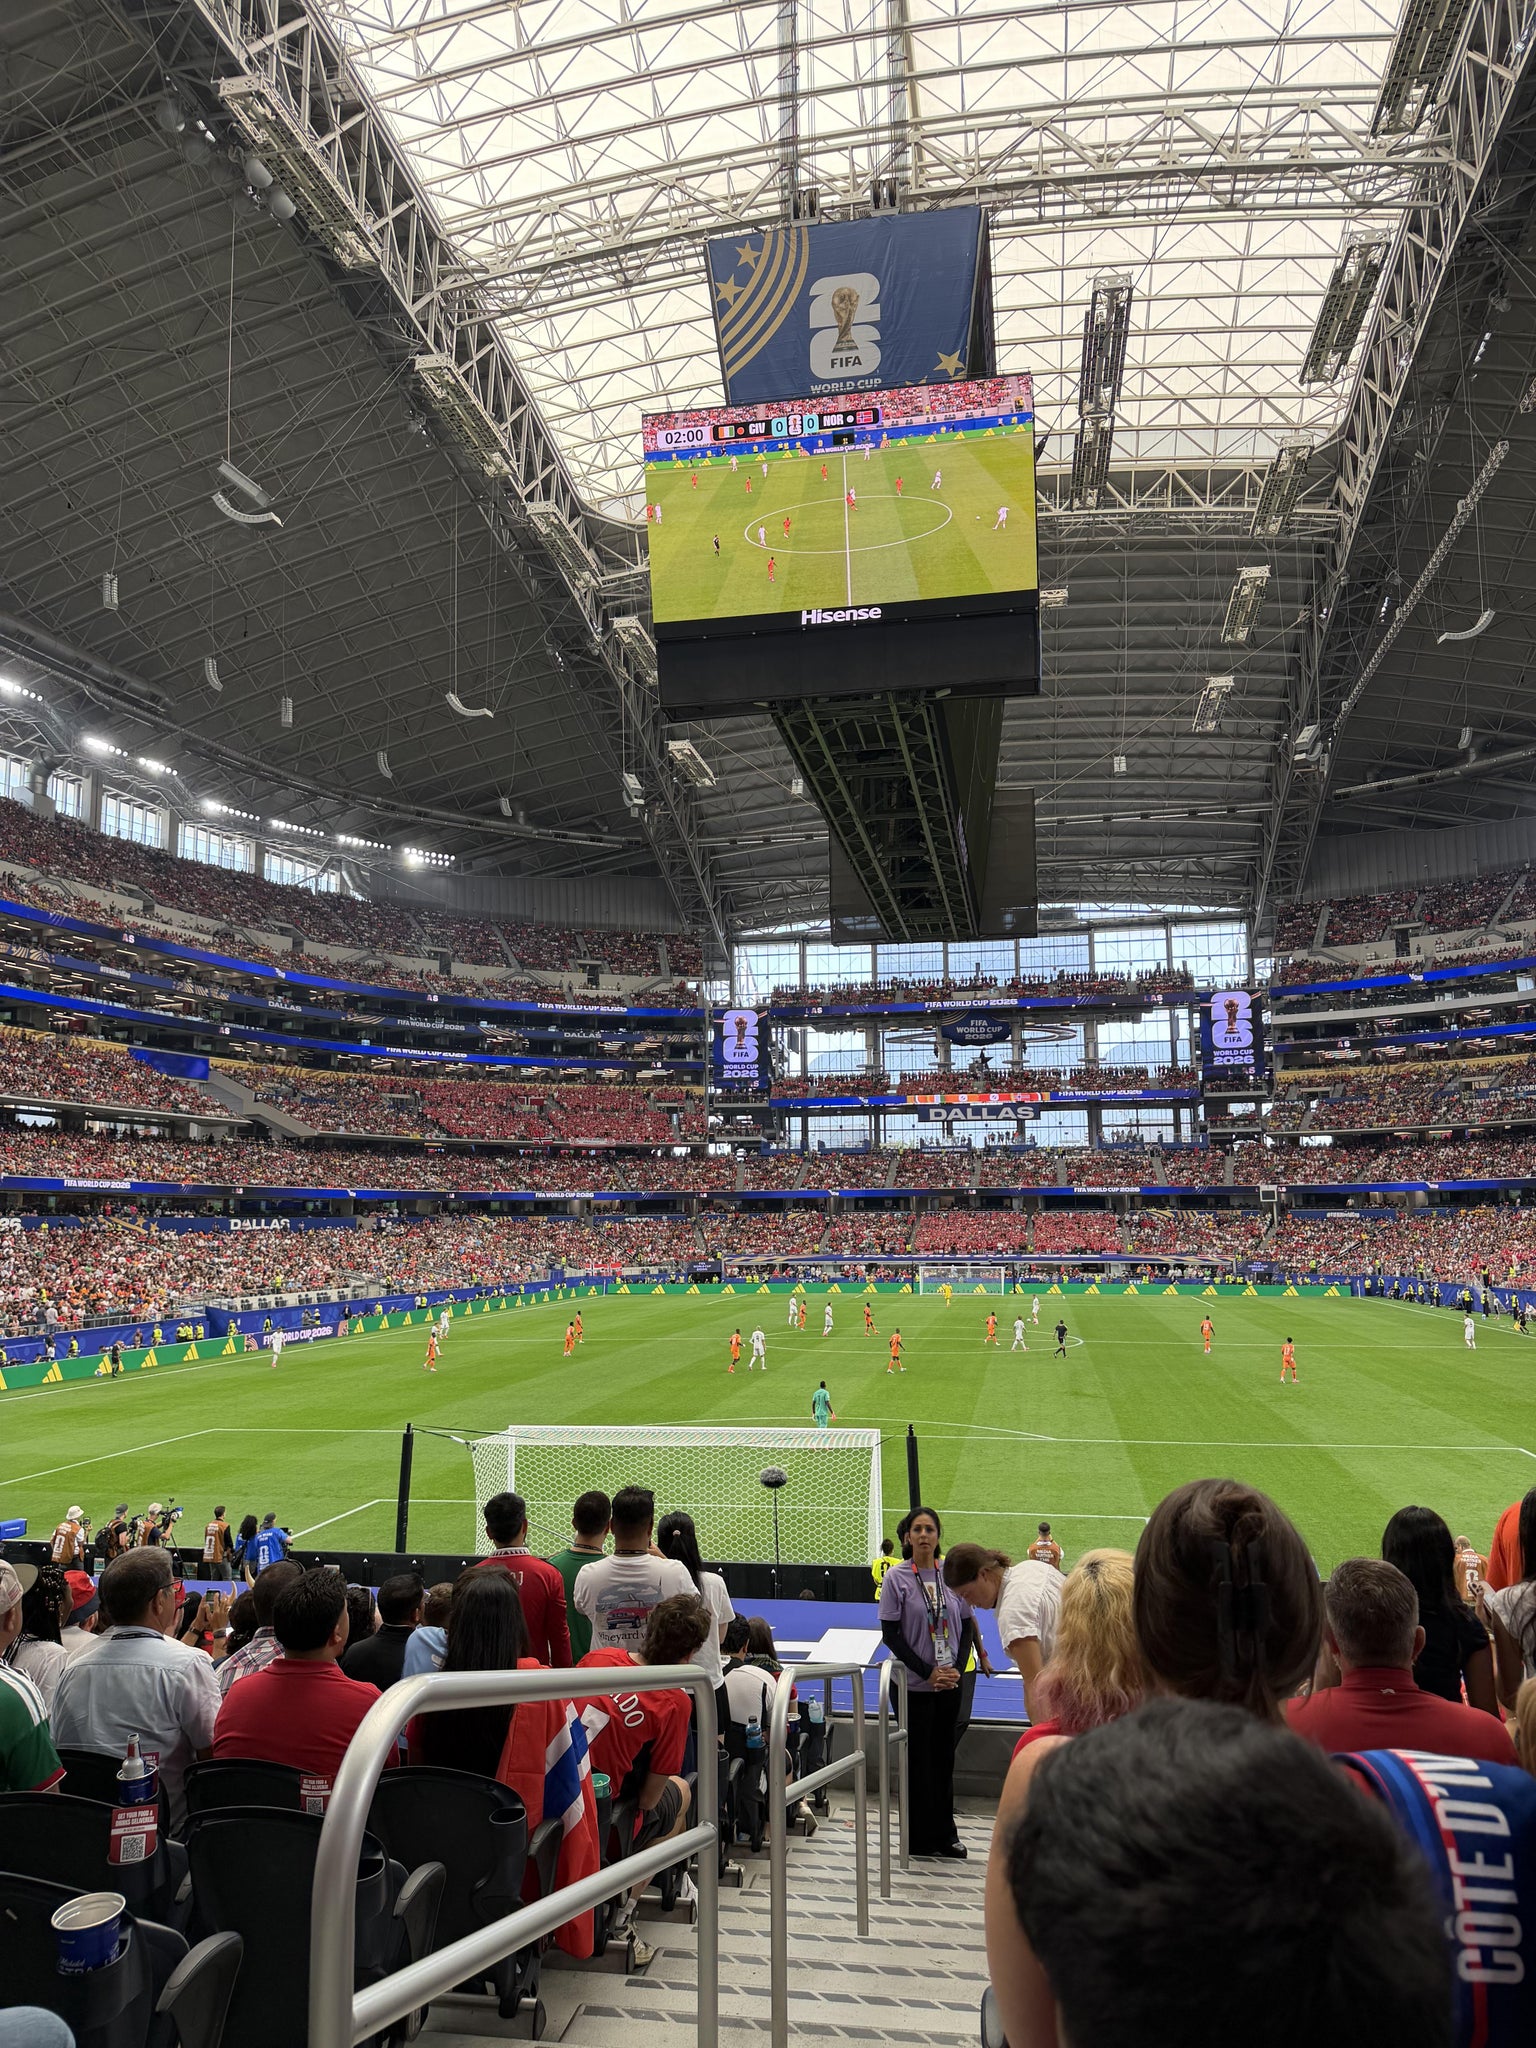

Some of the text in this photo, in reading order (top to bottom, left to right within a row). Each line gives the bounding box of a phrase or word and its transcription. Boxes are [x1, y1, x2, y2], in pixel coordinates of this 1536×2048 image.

[830, 356, 862, 369] FIFA
[811, 378, 882, 394] WORLD CUP
[665, 414, 844, 445] 02:00 CIV 0 0 NOR
[801, 607, 882, 625] Hisense
[268, 1001, 302, 1013] DALLAS
[943, 1000, 971, 1008] WORLD
[411, 1021, 431, 1029] WORLD
[1224, 1036, 1242, 1044] FIFA
[1213, 1056, 1255, 1065] 2026
[723, 1070, 759, 1078] 2026
[929, 1106, 1035, 1121] DALLAS
[78, 1180, 98, 1188] WORLD
[111, 1181, 131, 1189] 2026
[229, 1218, 290, 1231] DALLAS
[300, 1330, 312, 1339] CUP
[609, 1692, 645, 1728] LDO
[126, 1811, 137, 1819] YOUR
[138, 1810, 149, 1818] FOOD
[1444, 1847, 1525, 1984] CÔTE
